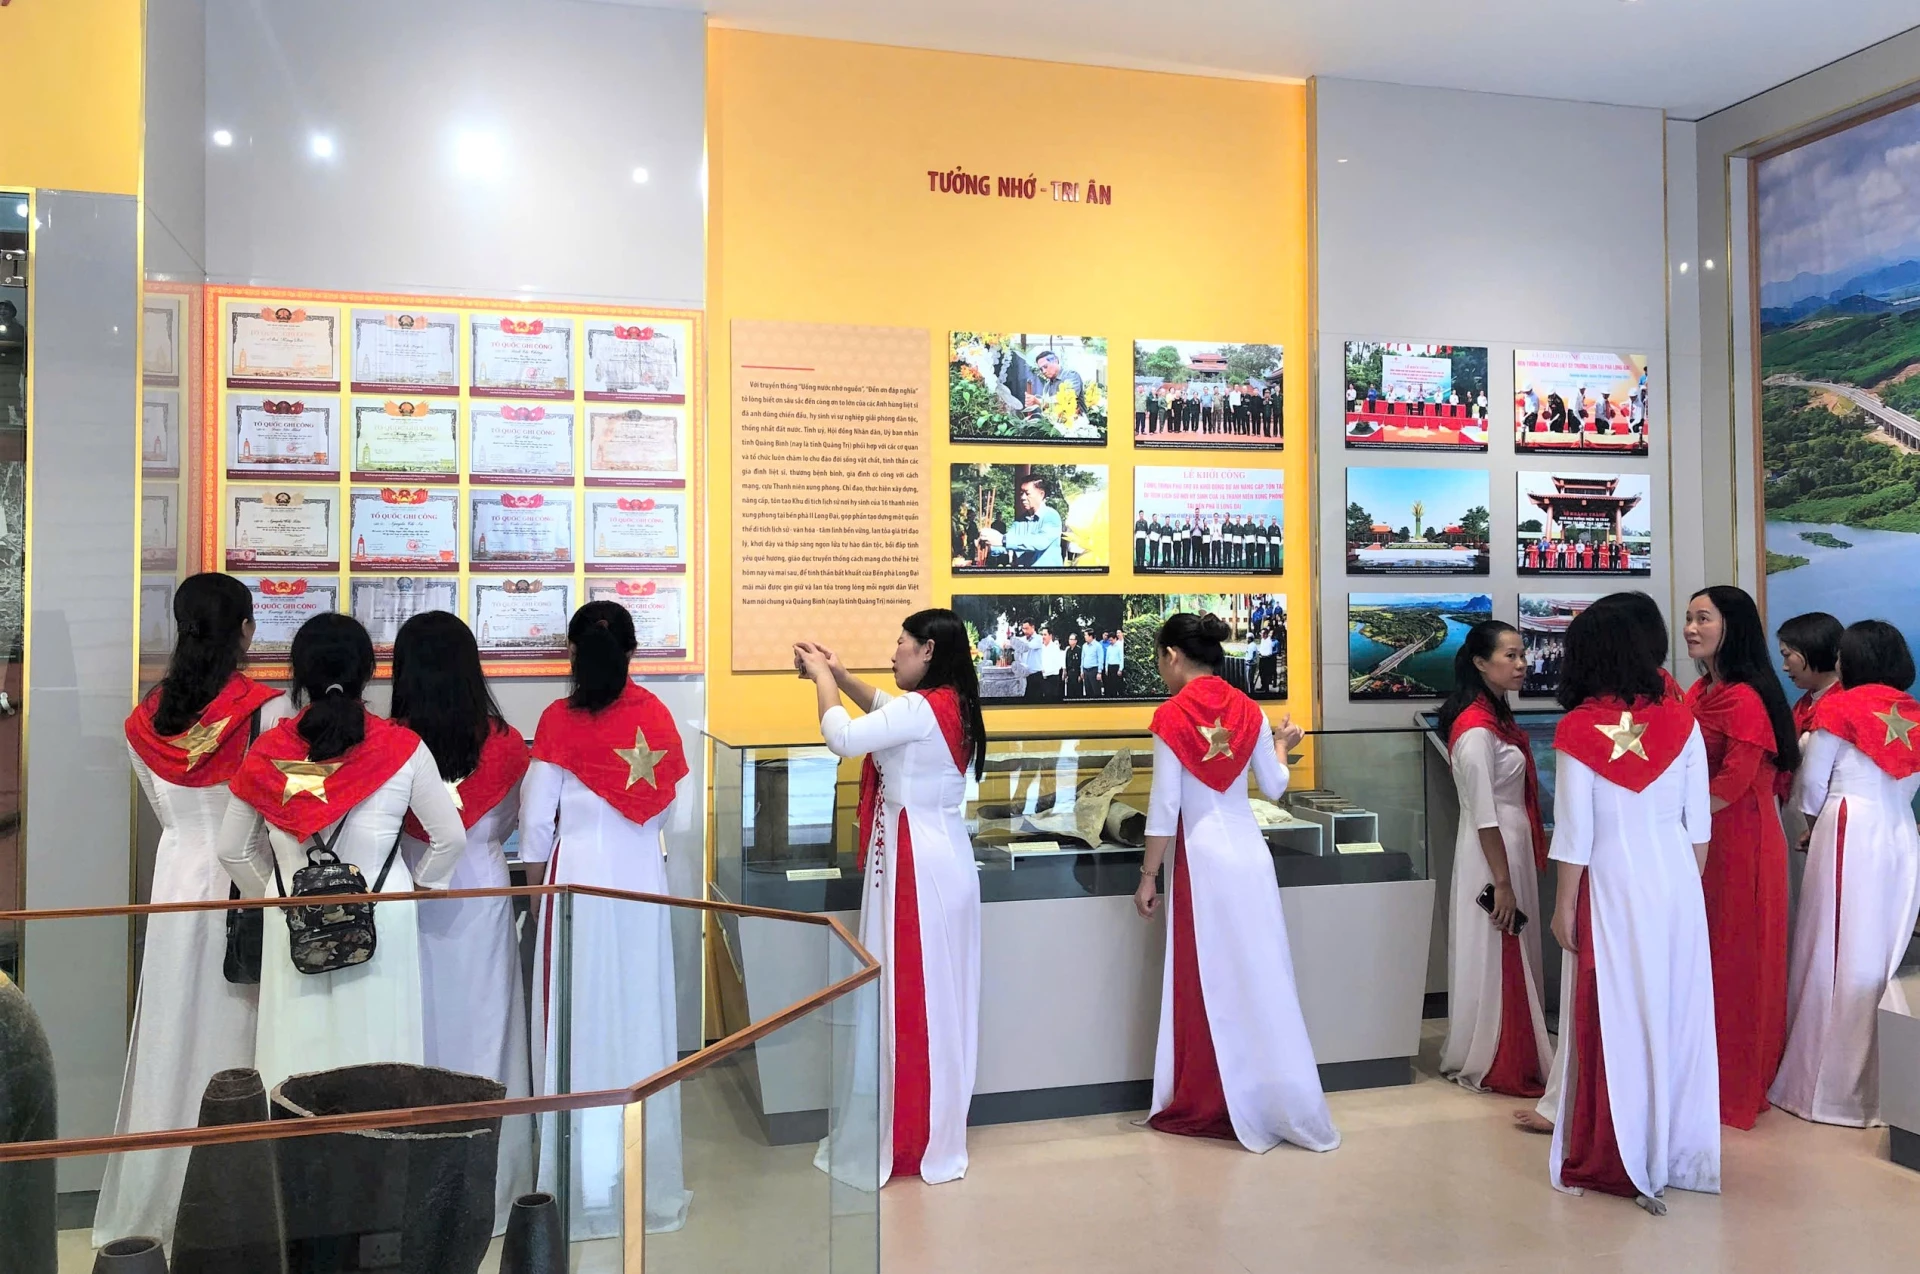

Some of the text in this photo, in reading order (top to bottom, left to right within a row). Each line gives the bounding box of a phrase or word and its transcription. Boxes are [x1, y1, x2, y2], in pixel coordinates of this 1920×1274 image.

[928, 166, 990, 196] TƯỞNG
[998, 173, 1036, 200] NHỚ
[1051, 180, 1080, 202] TRI
[1086, 179, 1112, 205] ÂN
[766, 598, 784, 606] chung
